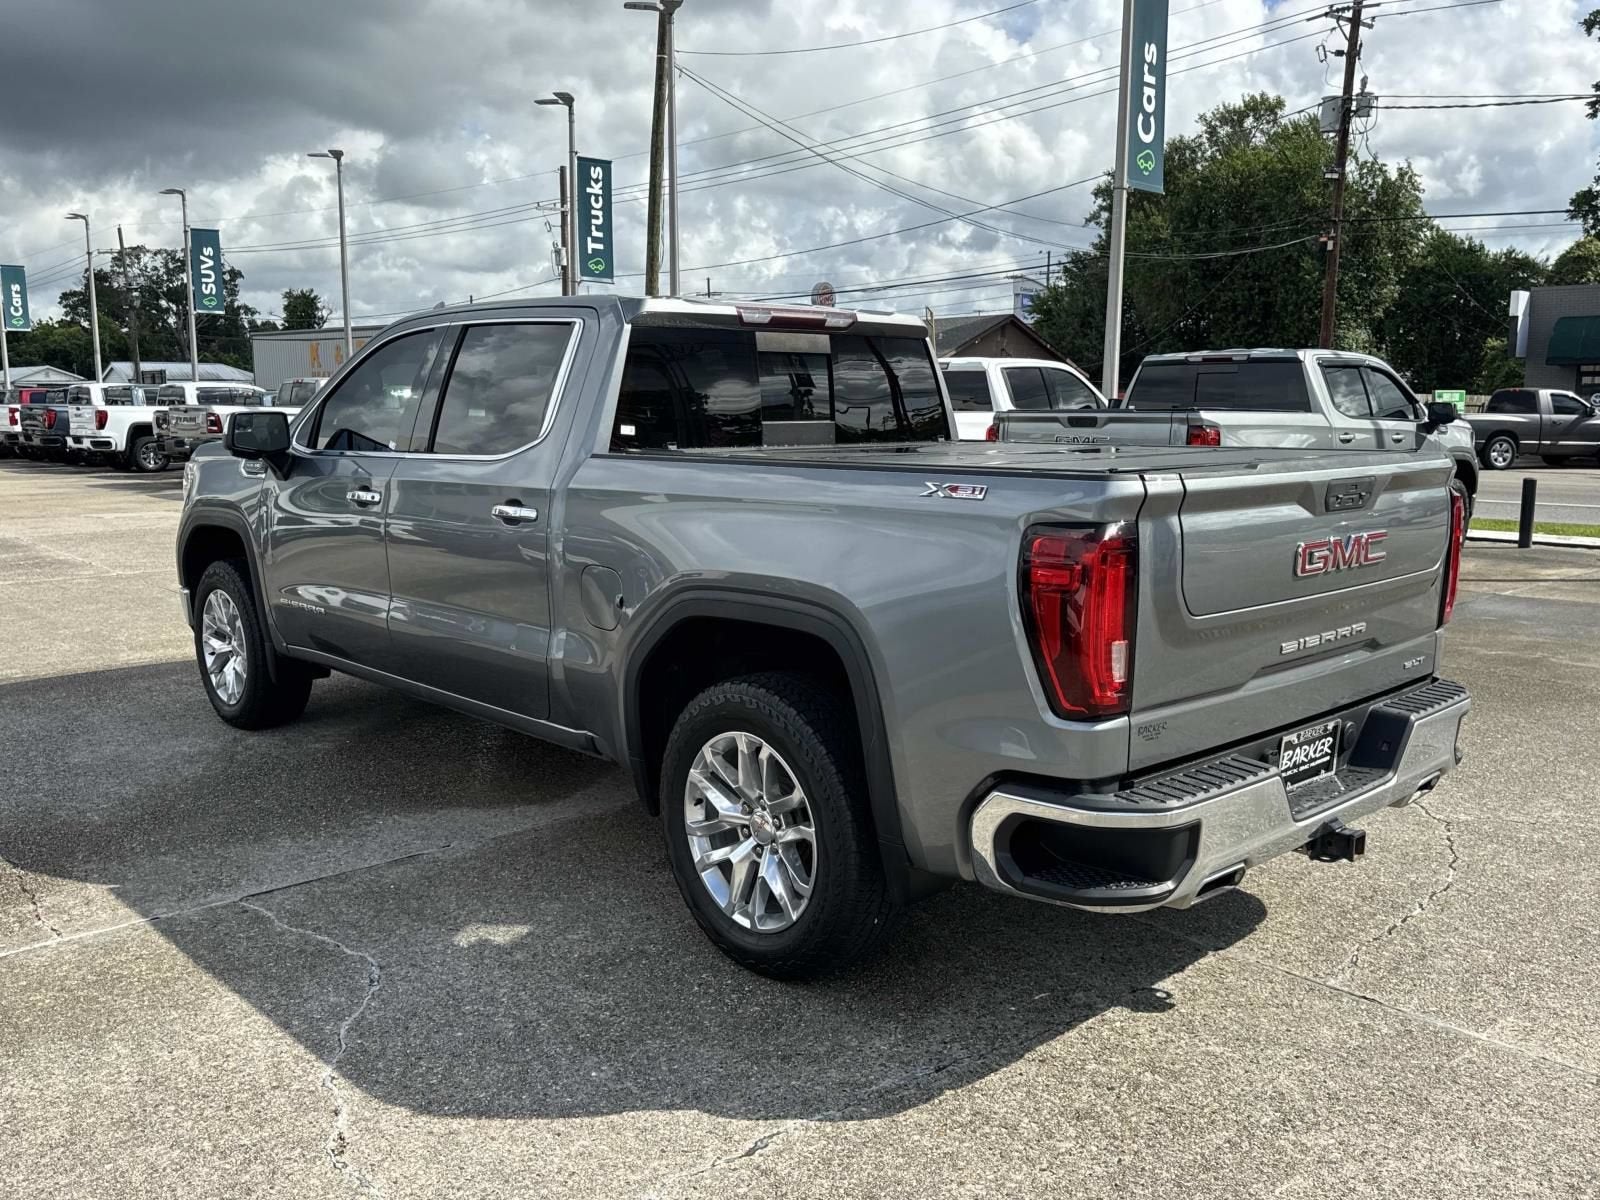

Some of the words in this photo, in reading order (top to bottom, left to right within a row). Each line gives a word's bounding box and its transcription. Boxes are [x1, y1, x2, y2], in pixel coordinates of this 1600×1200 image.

[1137, 42, 1157, 144] Cars
[586, 166, 604, 254] Trucks
[200, 246, 216, 295] SUVs
[10, 283, 23, 317] Cars
[1296, 530, 1388, 577] GMC
[280, 599, 325, 614] SIERRA
[1281, 622, 1367, 655] SIERRA
[1404, 656, 1426, 670] SLT
[1281, 737, 1333, 770] BARKER
